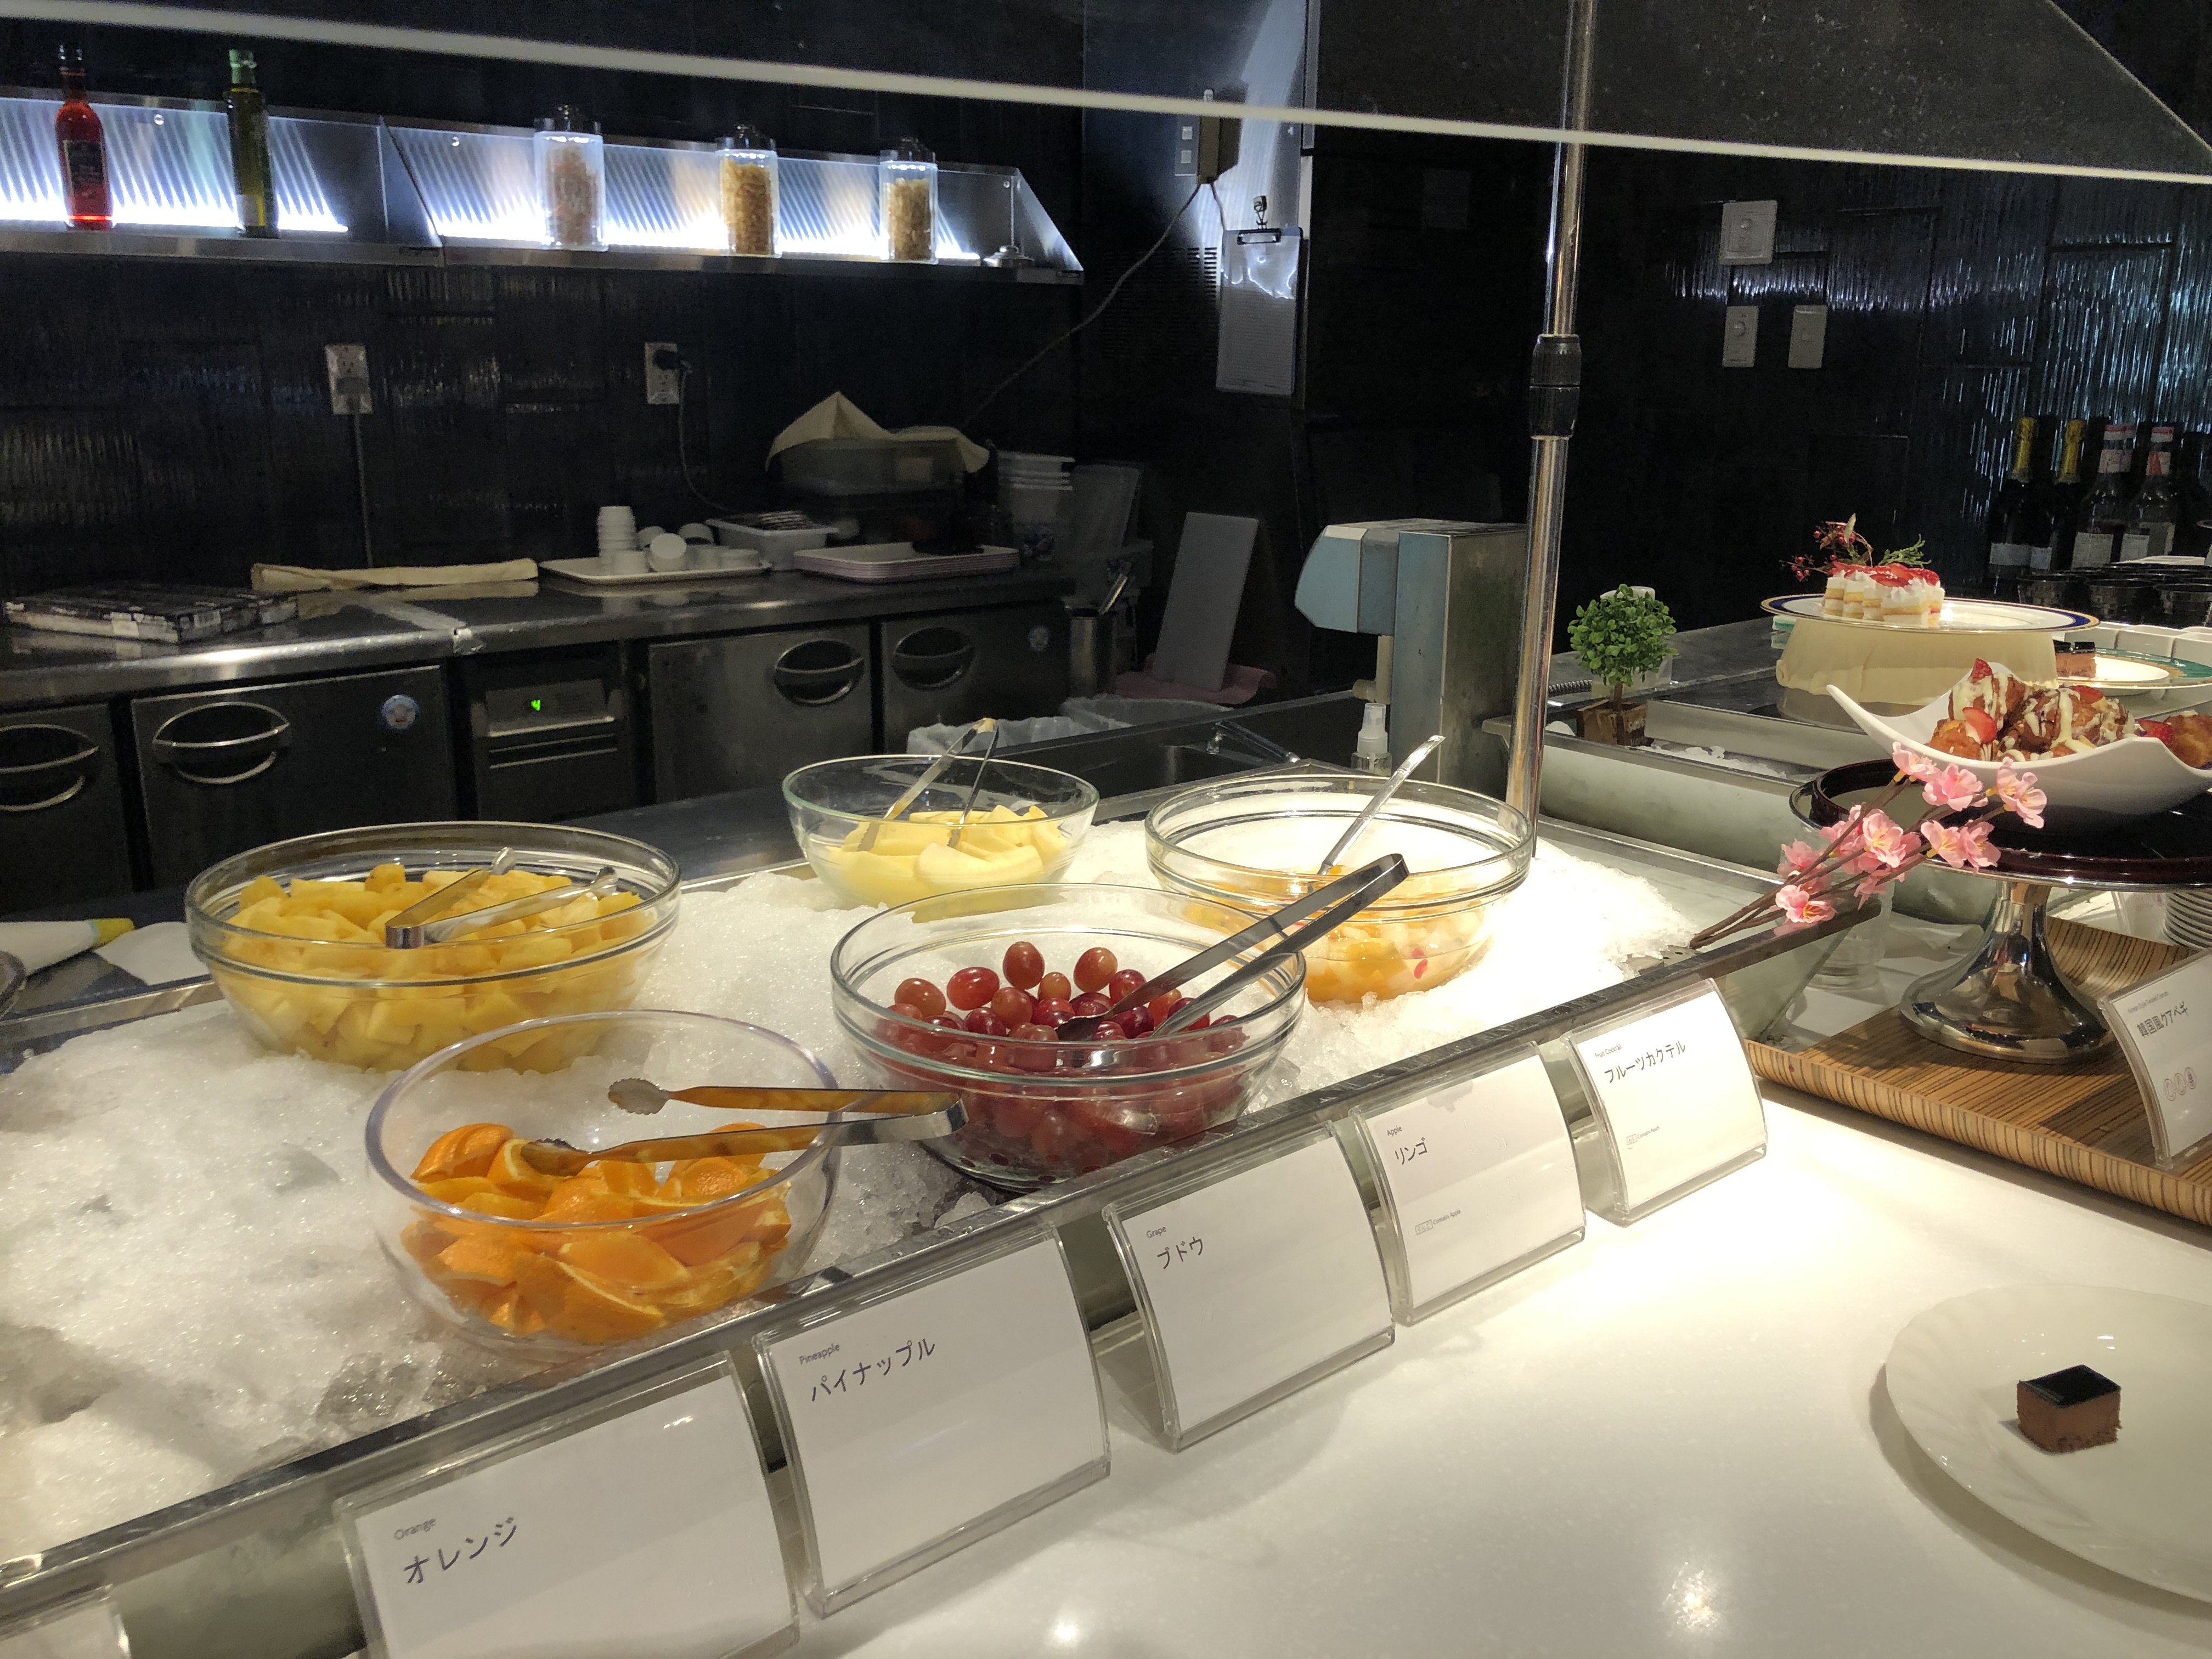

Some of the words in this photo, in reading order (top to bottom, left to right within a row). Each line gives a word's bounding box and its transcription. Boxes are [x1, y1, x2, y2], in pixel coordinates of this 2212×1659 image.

[1604, 1041, 1686, 1084] フルーツカクテル
[1387, 1125, 1402, 1137] Apple
[1395, 1137, 1427, 1165] リンゴ
[1146, 1226, 1167, 1239] Grape
[1156, 1236, 1203, 1269] ブドウ
[799, 1343, 840, 1365] Pineapple
[811, 1338, 935, 1402] パイナップル
[394, 1518, 436, 1541] Orange
[403, 1517, 517, 1584] オレンジ
